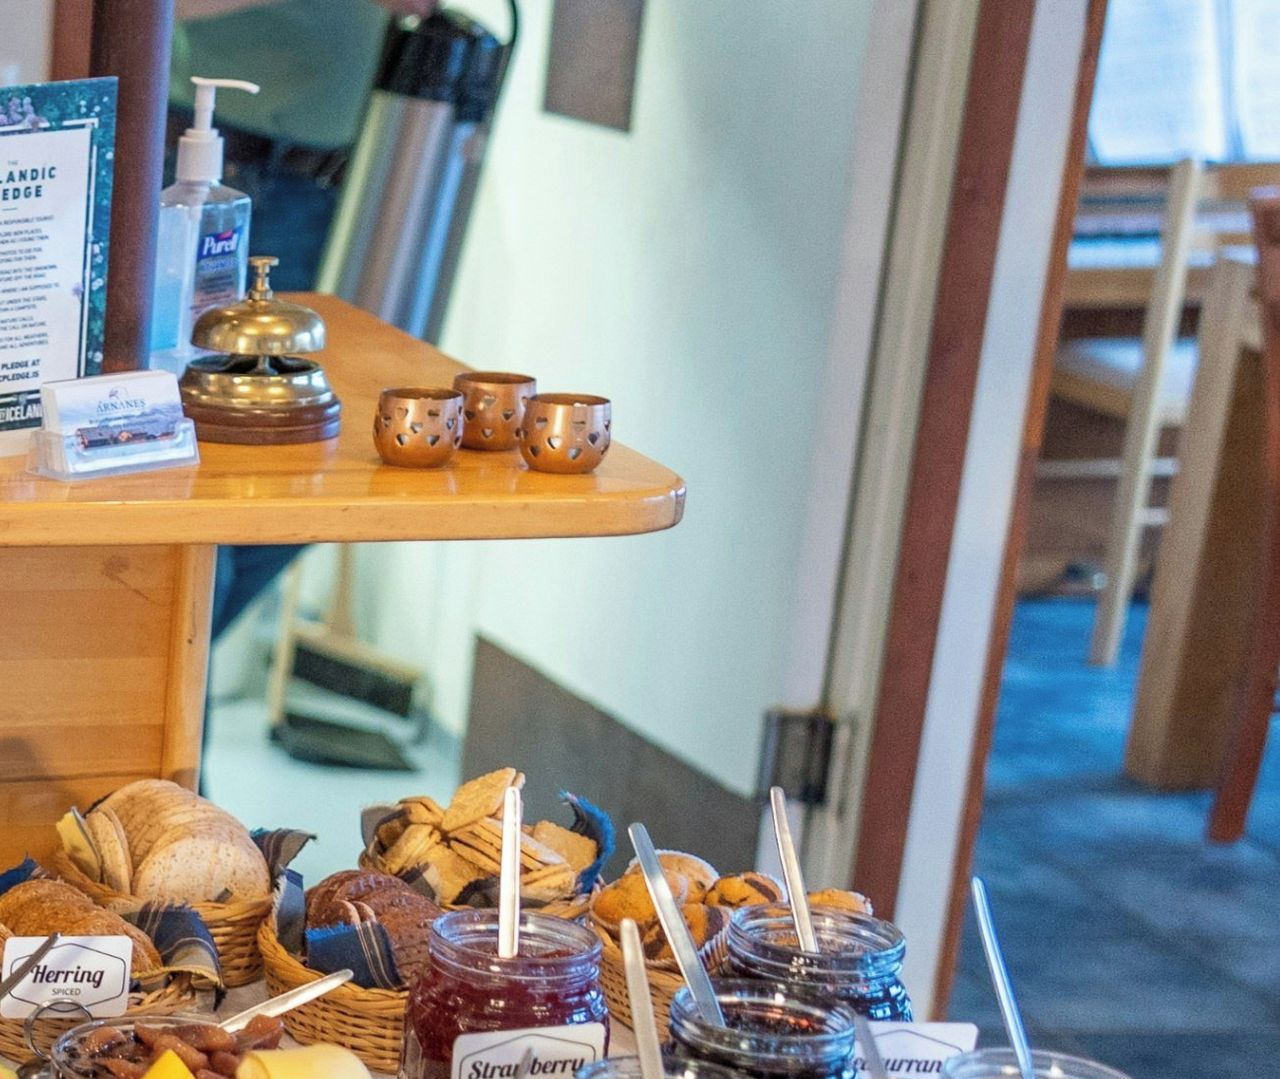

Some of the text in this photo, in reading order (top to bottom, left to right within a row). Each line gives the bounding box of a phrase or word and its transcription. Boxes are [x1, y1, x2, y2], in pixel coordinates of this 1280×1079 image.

[1, 360, 29, 371] PLEDGE
[31, 359, 41, 367] AT
[6, 403, 42, 421] ICELAN
[31, 965, 105, 989] Herring
[51, 987, 82, 996] SPICED
